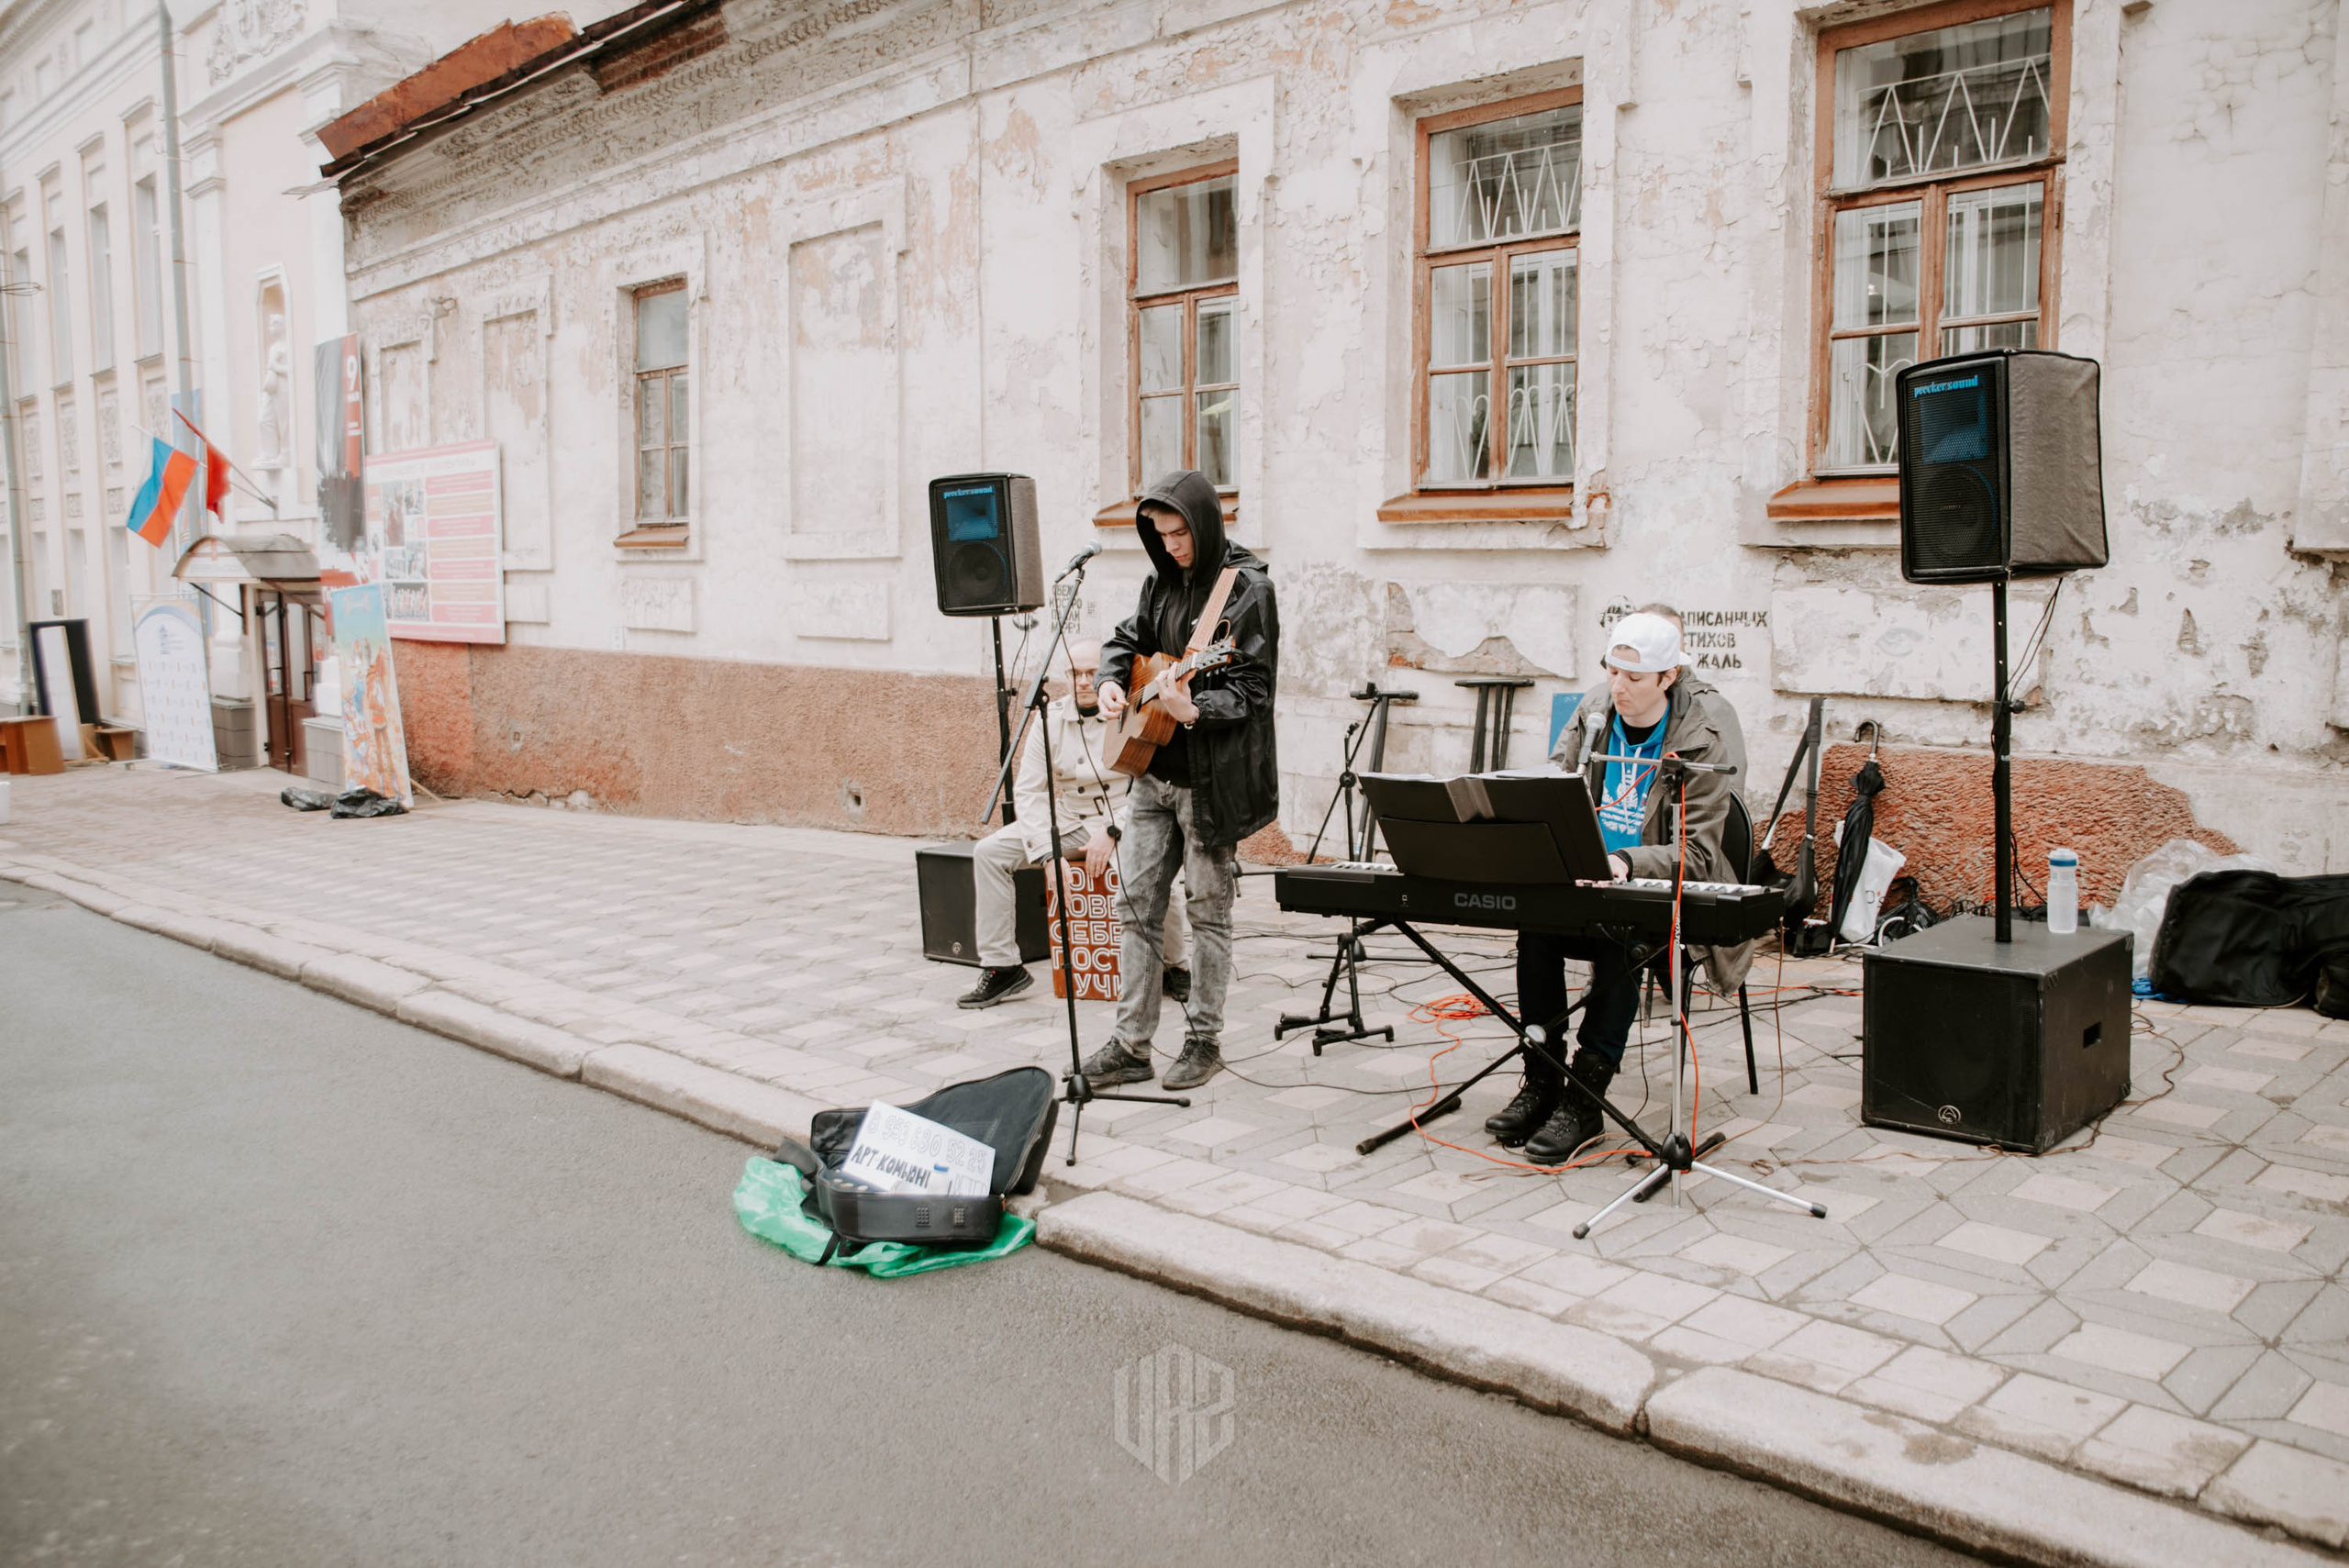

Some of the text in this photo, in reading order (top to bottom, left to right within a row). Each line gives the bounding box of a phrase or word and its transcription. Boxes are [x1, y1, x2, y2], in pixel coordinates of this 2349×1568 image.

[1697, 652, 1742, 669] ЖАЛЬ
[1453, 893, 1517, 910] CASIO
[852, 1144, 878, 1166] АРТ
